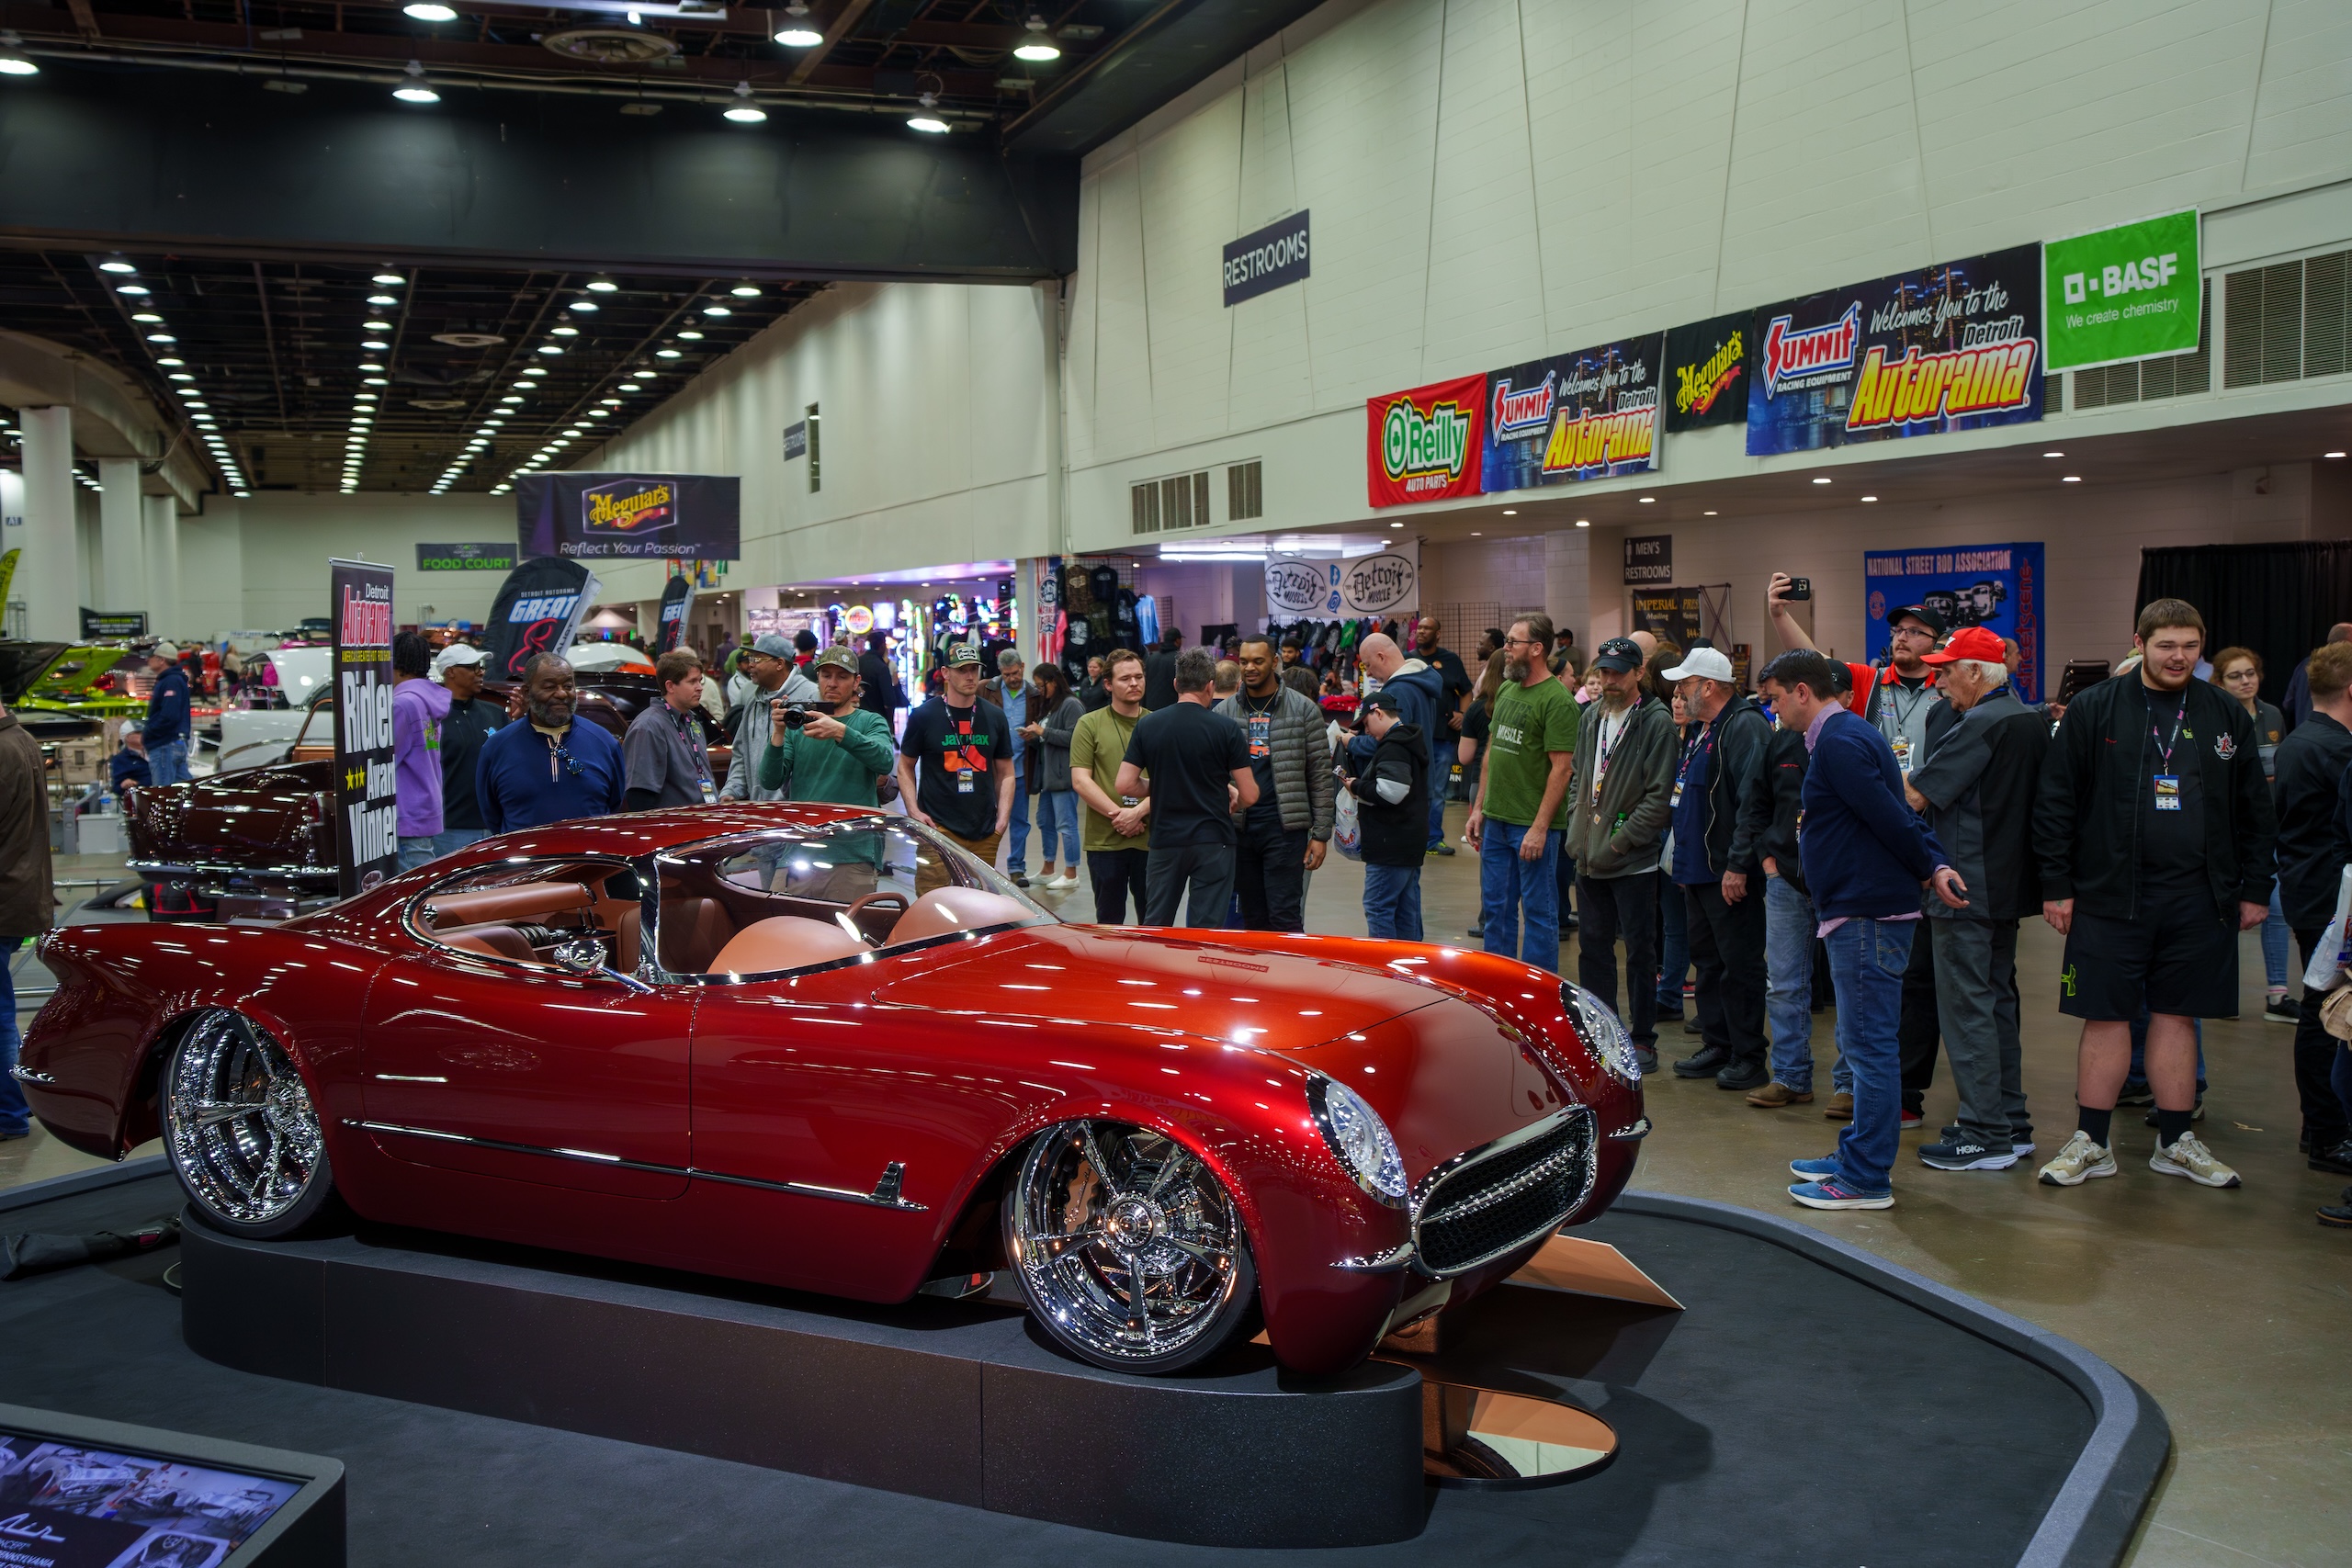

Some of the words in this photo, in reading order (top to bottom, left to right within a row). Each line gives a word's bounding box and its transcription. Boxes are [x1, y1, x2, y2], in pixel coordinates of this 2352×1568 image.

[1224, 230, 1307, 288] RESTROOMS
[2102, 252, 2177, 298] BASF
[1869, 299, 1932, 334] Welcomes
[1932, 294, 1963, 338] You
[1963, 288, 1981, 313] to
[1981, 280, 2009, 312] the
[2065, 314, 2083, 329] We
[2086, 309, 2120, 325] create
[2122, 298, 2179, 319] chemistry
[1962, 315, 2024, 347] Detroit
[1765, 310, 1857, 393] SUMMIT
[1558, 370, 1600, 398] Welcomes
[1598, 367, 1620, 402] You
[1618, 364, 1629, 386] to
[1629, 358, 1647, 383] the
[1676, 331, 1744, 413] Meguiar's
[1776, 378, 1805, 392] RACING
[1805, 370, 1853, 388] EQUIPMENT
[1846, 337, 2039, 432] Autorama
[1617, 386, 1657, 412] Detroit
[1385, 405, 1466, 472] O'Reilly
[1500, 430, 1519, 442] RACING
[1519, 424, 1548, 437] EQUIPMENT
[1405, 476, 1424, 492] AUTO
[1425, 474, 1448, 490] PARTS
[588, 484, 671, 528] Meguiar's
[560, 542, 609, 557] Reflect
[613, 541, 642, 555] Your
[1634, 541, 1660, 556] MEN'S
[423, 558, 462, 570] FOOD
[465, 558, 511, 570] COURT
[1625, 564, 1671, 580] RESTROOMS
[1867, 557, 1905, 576] NATIONAL
[1905, 555, 1934, 575] STREET
[1936, 553, 1953, 574] ROD
[1954, 549, 2011, 572] ASSOCIATION
[366, 582, 389, 600] Detroit
[520, 590, 543, 598] DETROIT
[545, 587, 575, 596] AUTORAMA
[1352, 561, 1405, 603] Detroit
[1366, 587, 1391, 604] MUSCLE
[341, 584, 390, 647] Autorama
[508, 595, 581, 623] GREAT
[1635, 598, 1678, 611] IMPERIAL
[1682, 598, 1700, 610] PRES
[342, 670, 394, 753] Ridler
[1496, 724, 1523, 745] MUSCLE
[367, 754, 396, 801] Award
[1956, 1145, 1985, 1155] HOKA
